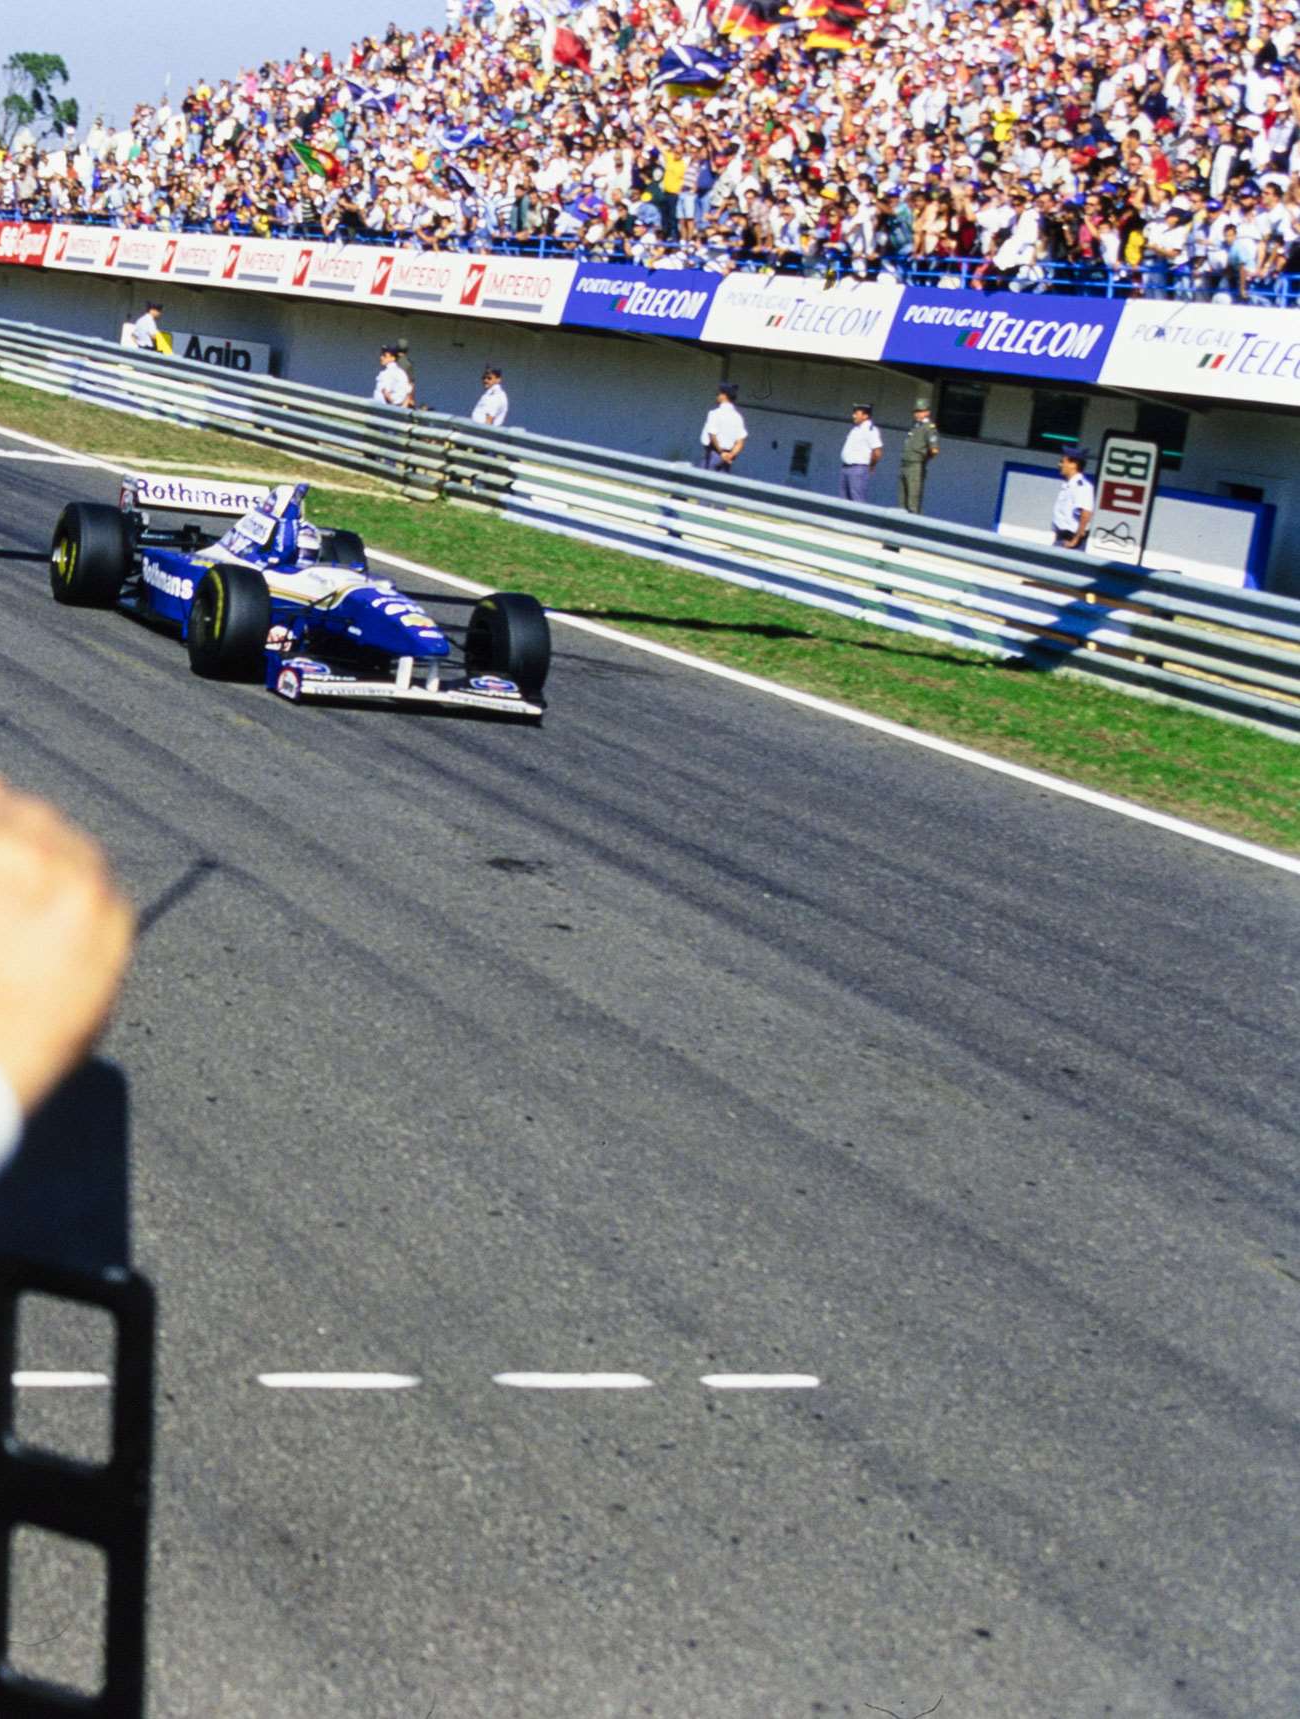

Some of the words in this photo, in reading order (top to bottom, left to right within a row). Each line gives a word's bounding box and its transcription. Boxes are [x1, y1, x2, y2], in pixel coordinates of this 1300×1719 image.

[487, 271, 551, 298] IMPERIO
[576, 277, 634, 297] PORTUGAL
[624, 282, 708, 320] TELECOM
[782, 298, 881, 337] TELECOM
[903, 304, 988, 329] PORTUGAL
[976, 311, 1104, 360] TELECOM
[1132, 324, 1236, 347] PORTUGAL
[184, 335, 251, 371] Agip
[137, 479, 261, 509] Rothmans
